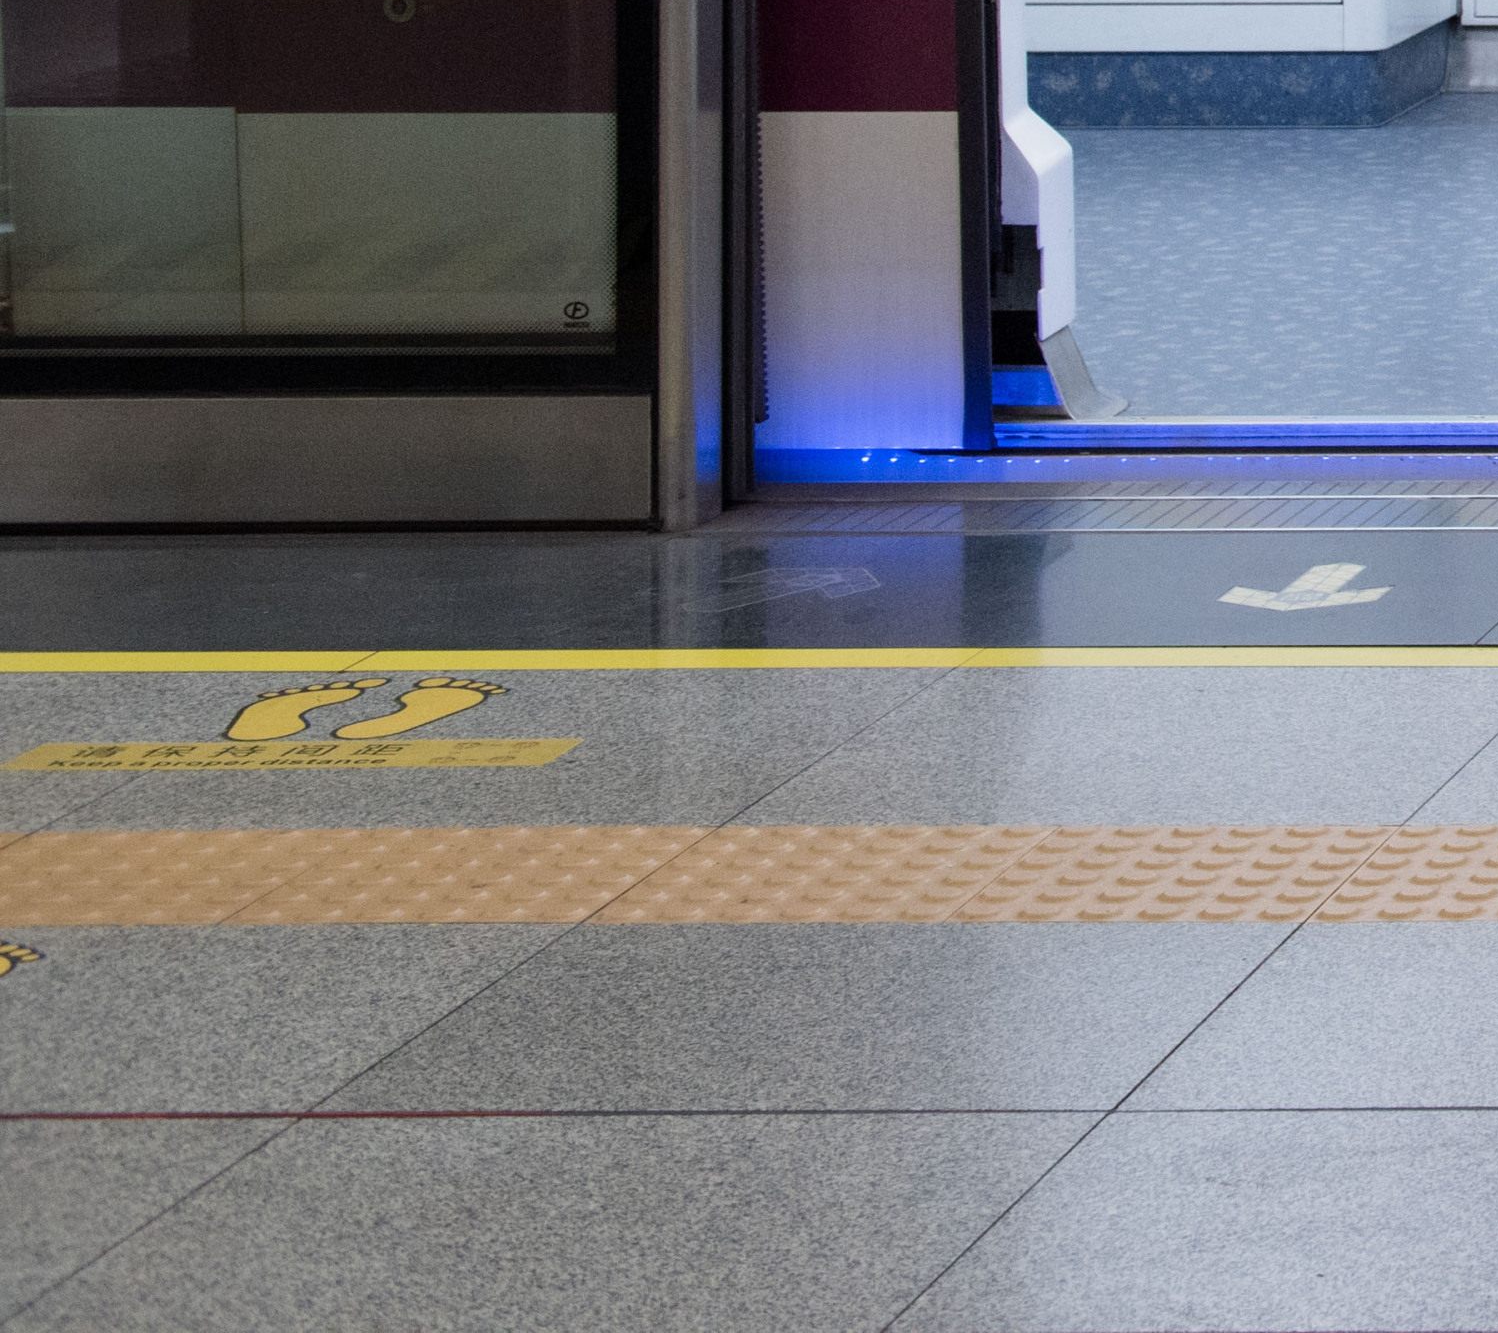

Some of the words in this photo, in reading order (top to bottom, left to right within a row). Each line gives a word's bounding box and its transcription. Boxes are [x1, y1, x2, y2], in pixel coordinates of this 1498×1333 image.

[71, 743, 411, 759] 请保持间距
[48, 759, 113, 769] Keep
[149, 759, 251, 769] proper
[259, 757, 387, 766] distance
